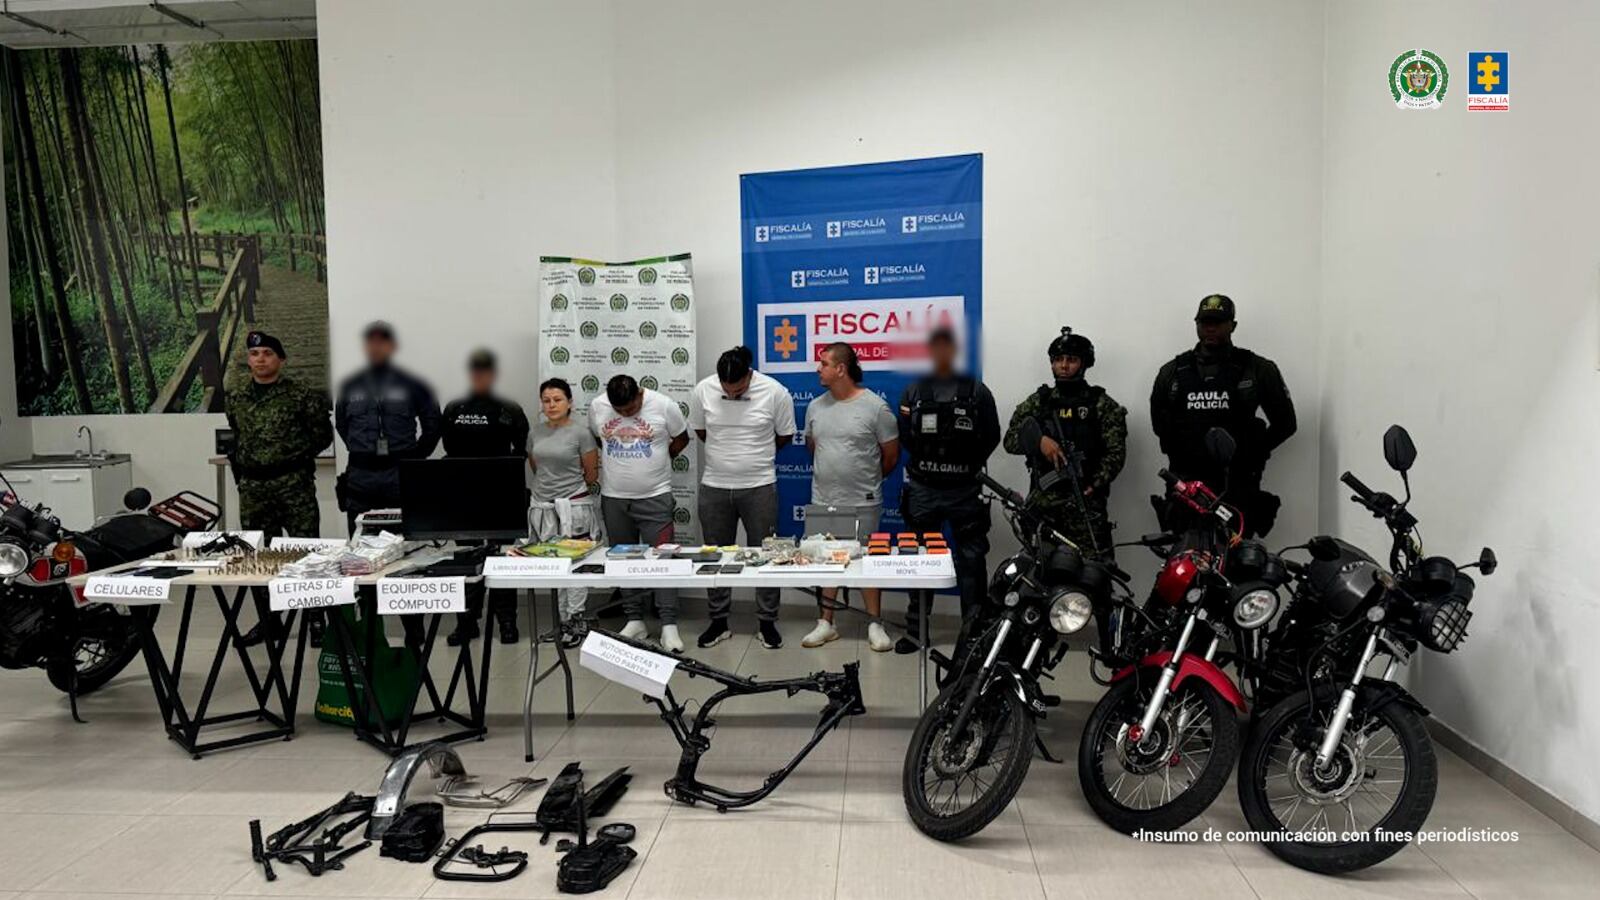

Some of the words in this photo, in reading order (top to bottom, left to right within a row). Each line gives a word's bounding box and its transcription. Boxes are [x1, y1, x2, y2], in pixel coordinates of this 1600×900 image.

[842, 218, 886, 230] FISCALÍA
[918, 212, 965, 224] FISCALÍA
[770, 222, 812, 235] FISCALÍA
[806, 268, 850, 279] FISCALÍA
[880, 264, 926, 275] FISCALÍA
[873, 347, 889, 357] DE
[1187, 390, 1230, 402] GAULA
[627, 566, 670, 574] CELULARES
[93, 583, 164, 597] CELULARES
[277, 580, 323, 594] LETRAS
[326, 579, 343, 590] DE
[381, 583, 436, 595] EQUIPOS
[440, 582, 457, 594] DE
[287, 595, 335, 609] CAMBIO
[599, 639, 653, 668] MOTOCICLETAS
[600, 650, 621, 664] AUTO
[620, 659, 650, 676] PARTES
